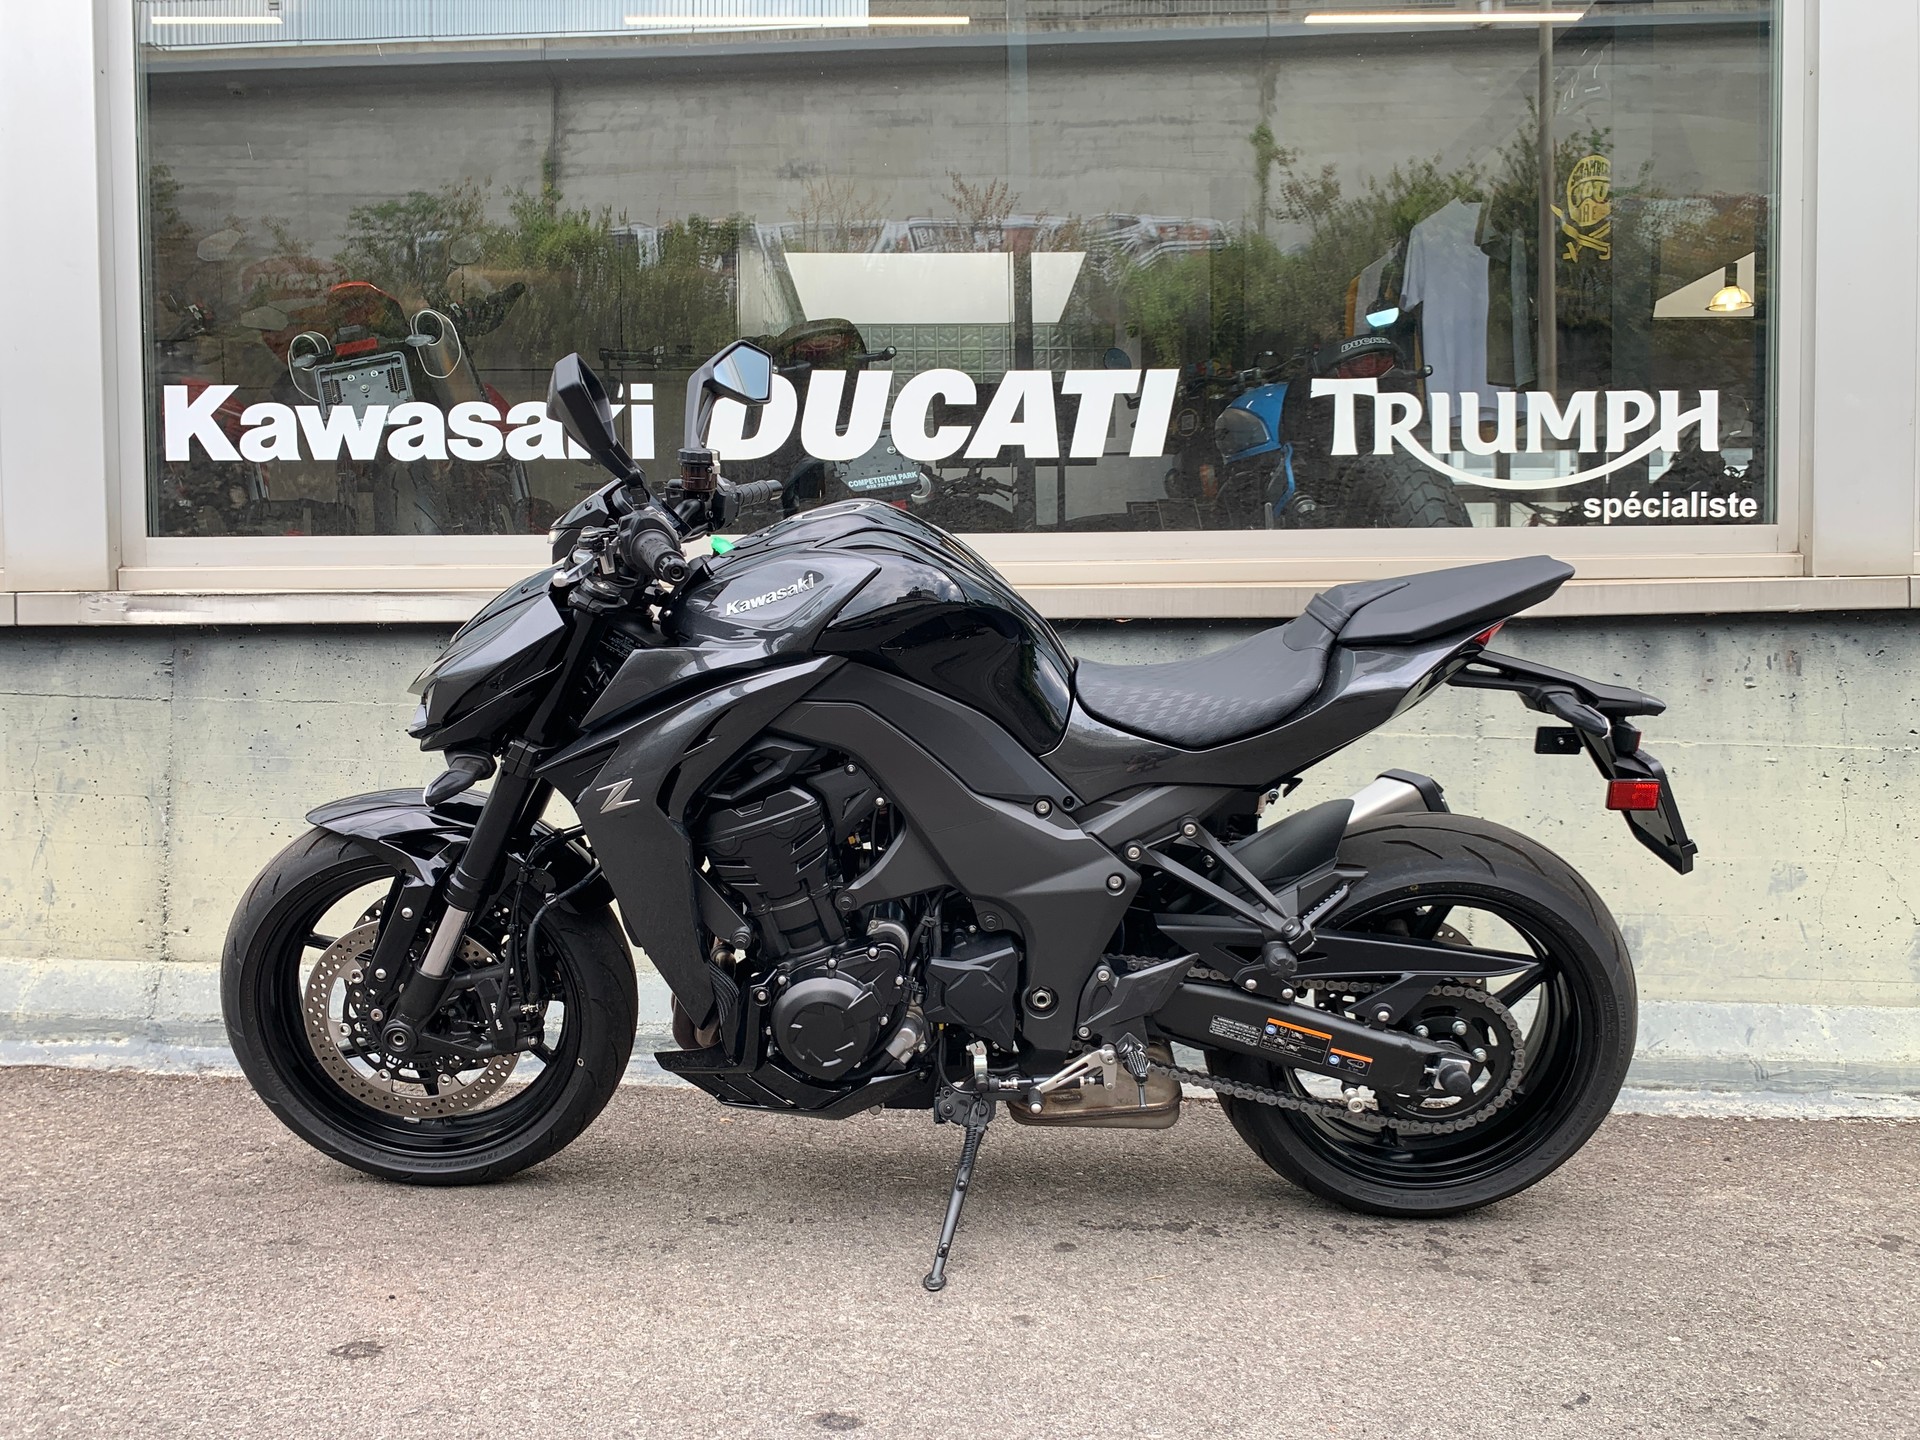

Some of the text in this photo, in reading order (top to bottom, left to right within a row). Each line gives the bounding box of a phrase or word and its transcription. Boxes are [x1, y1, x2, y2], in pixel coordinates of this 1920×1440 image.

[163, 384, 655, 463] Kawasai
[704, 368, 1180, 462] DUCATI
[1310, 377, 1719, 490] TRIUMPH
[848, 471, 918, 488] COMPETITION PARK
[1583, 490, 1758, 525] spécialiste
[725, 573, 816, 616] Kawasaki
